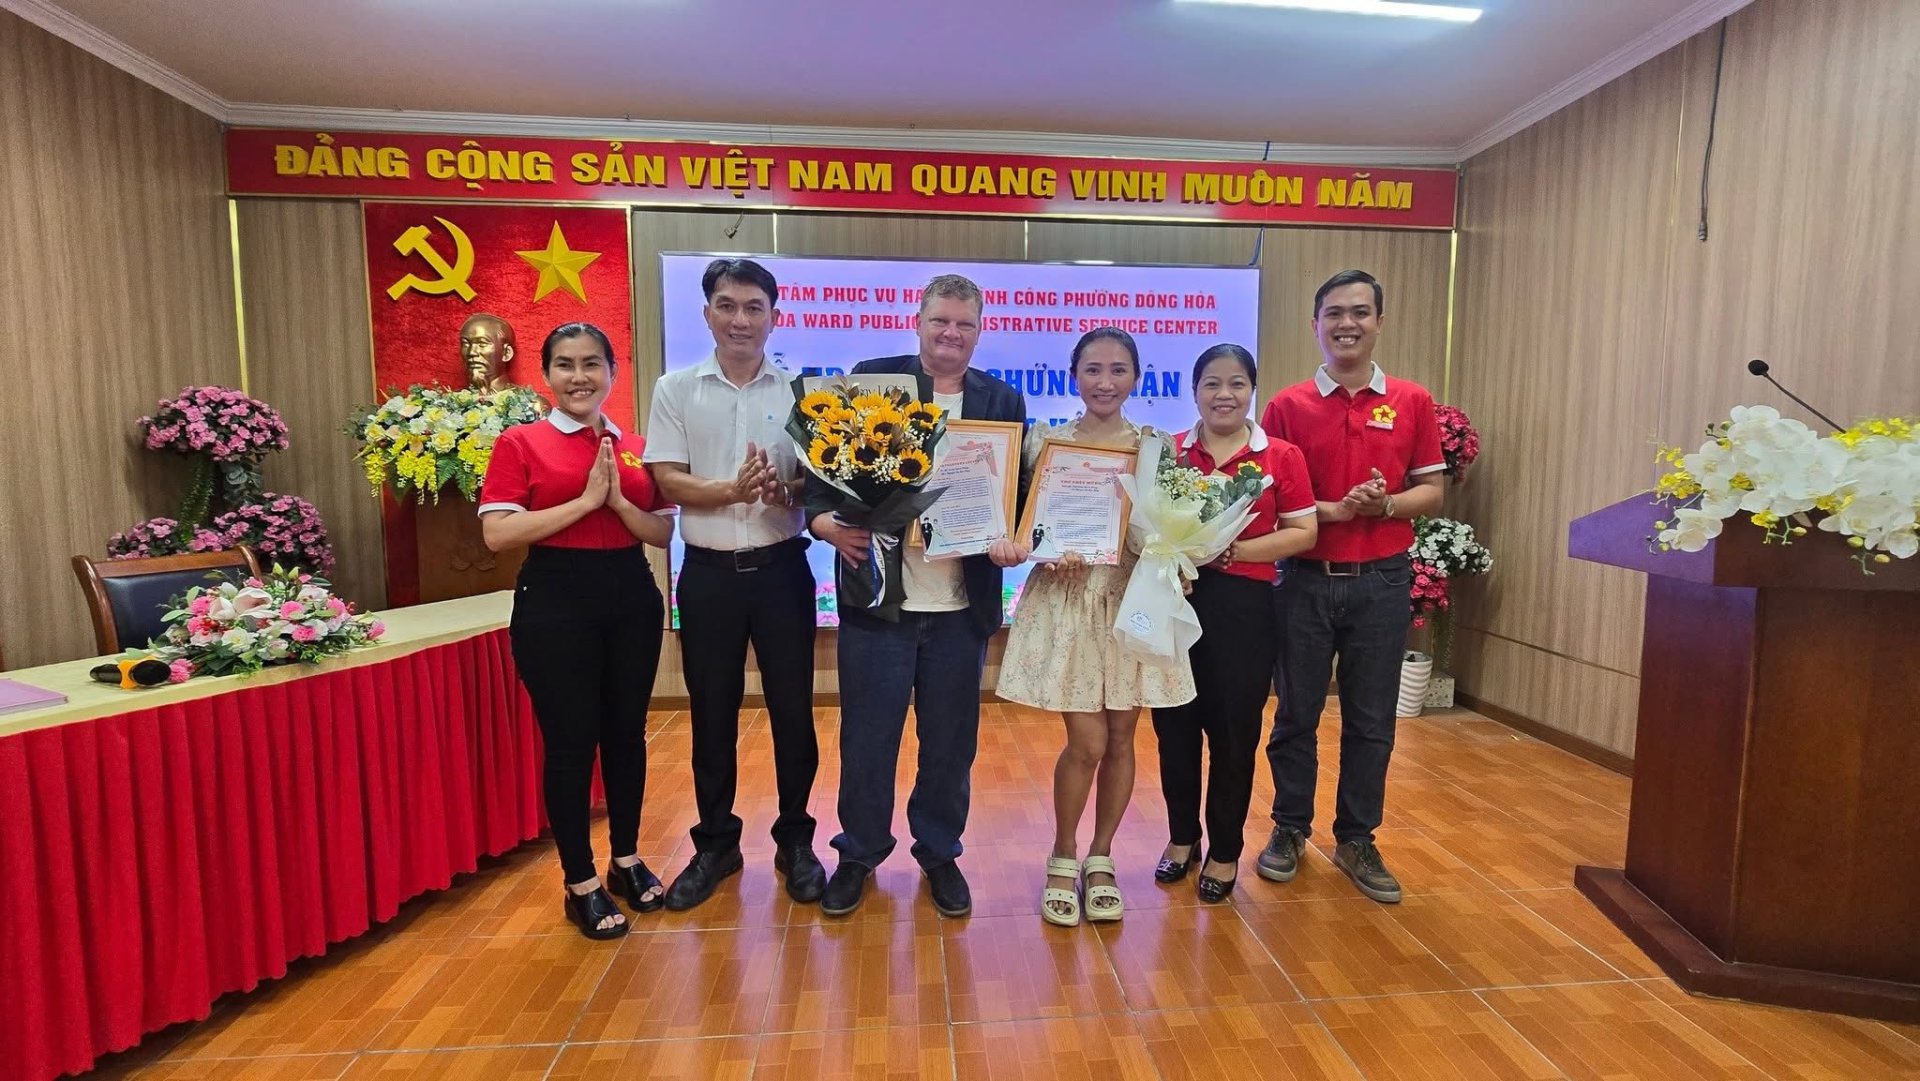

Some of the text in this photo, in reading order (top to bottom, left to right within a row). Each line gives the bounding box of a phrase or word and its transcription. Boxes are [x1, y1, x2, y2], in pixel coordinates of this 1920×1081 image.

[275, 133, 1413, 208] ĐẢNG CỘNG SẢN VIỆT NAM QUANG VINH MUÔN NĂM
[777, 282, 816, 301] TÂM
[823, 287, 868, 307] PHỤC
[875, 288, 896, 307] VỤ
[1014, 287, 1057, 306] CÔNG
[1063, 289, 1129, 308] PHƯỜNG
[1135, 290, 1178, 309] ĐÔNG
[1184, 290, 1216, 309] HÒA
[776, 313, 796, 328] OA
[803, 313, 854, 329] WARD
[982, 317, 1073, 333] ISTRATIVE
[1154, 319, 1218, 335] CENTER
